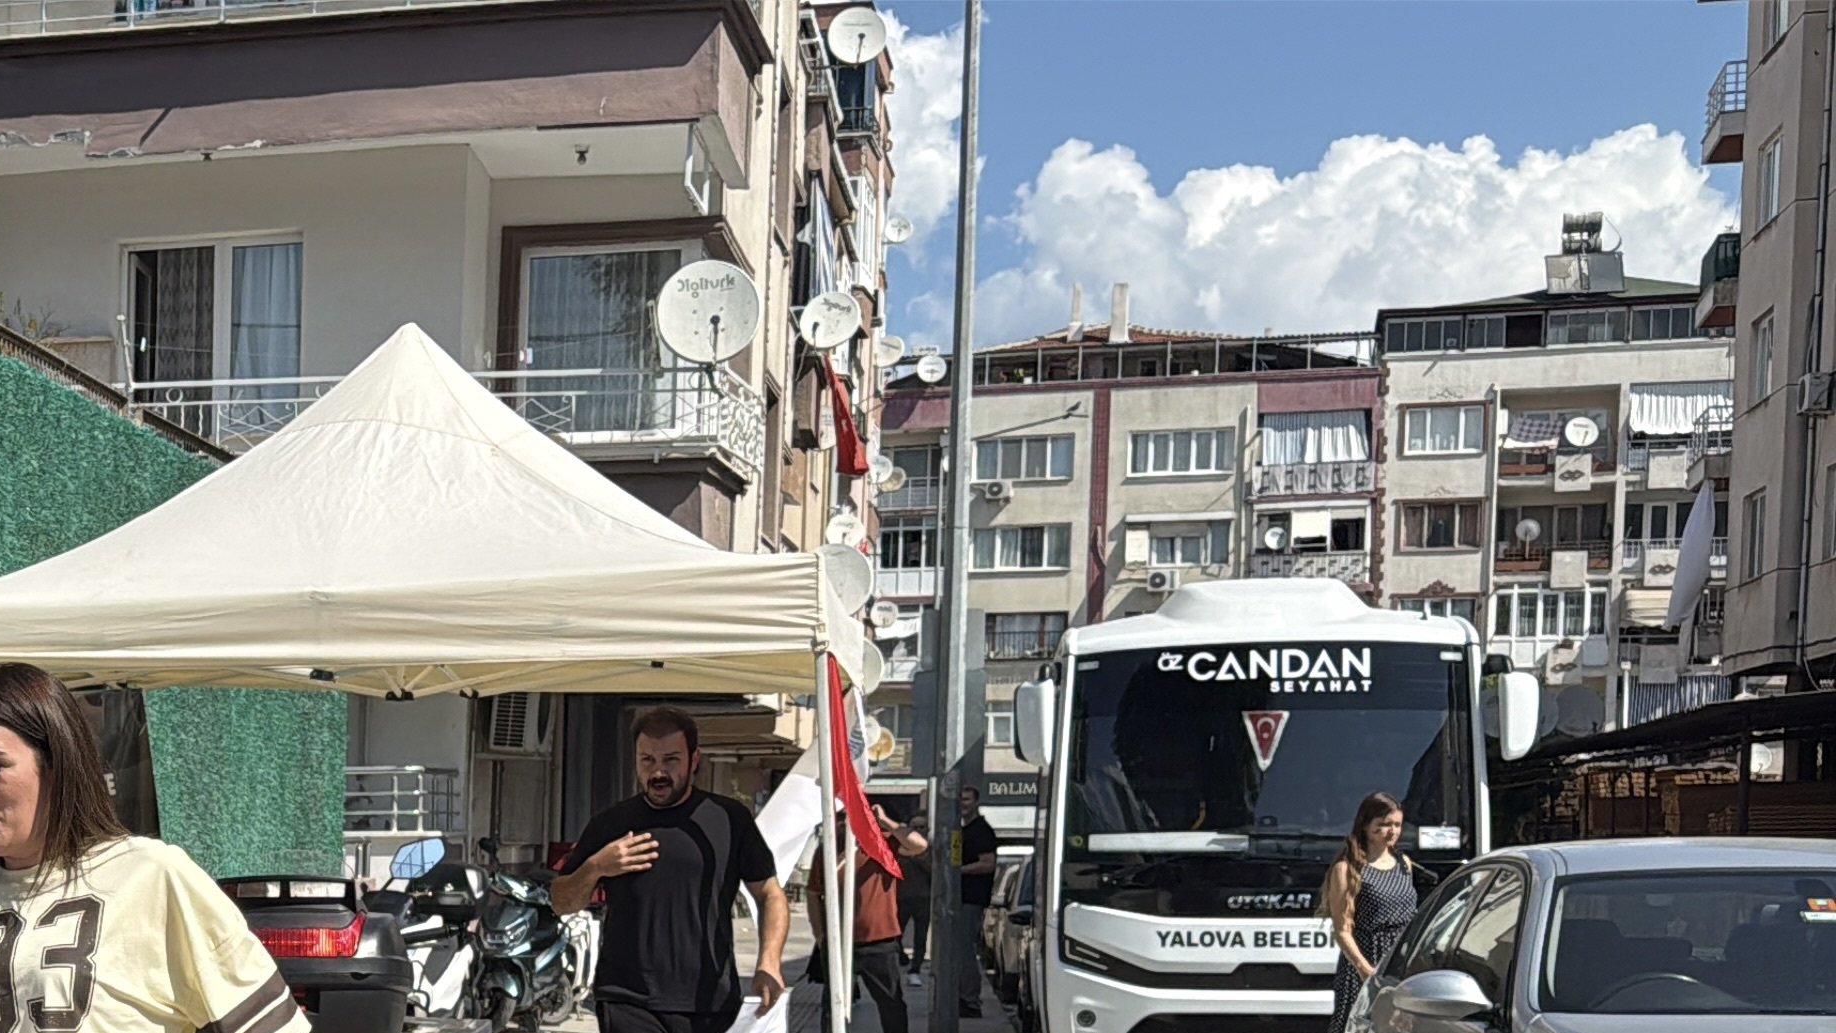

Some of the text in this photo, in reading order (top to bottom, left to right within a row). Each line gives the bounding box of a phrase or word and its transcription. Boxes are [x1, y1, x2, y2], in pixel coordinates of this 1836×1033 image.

[1187, 648, 1371, 681] CANDAN
[1270, 680, 1372, 693] SEYAHAT
[988, 782, 1038, 795] BALIM
[1227, 893, 1312, 909] OTOKAR
[1156, 931, 1245, 948] YALOVA
